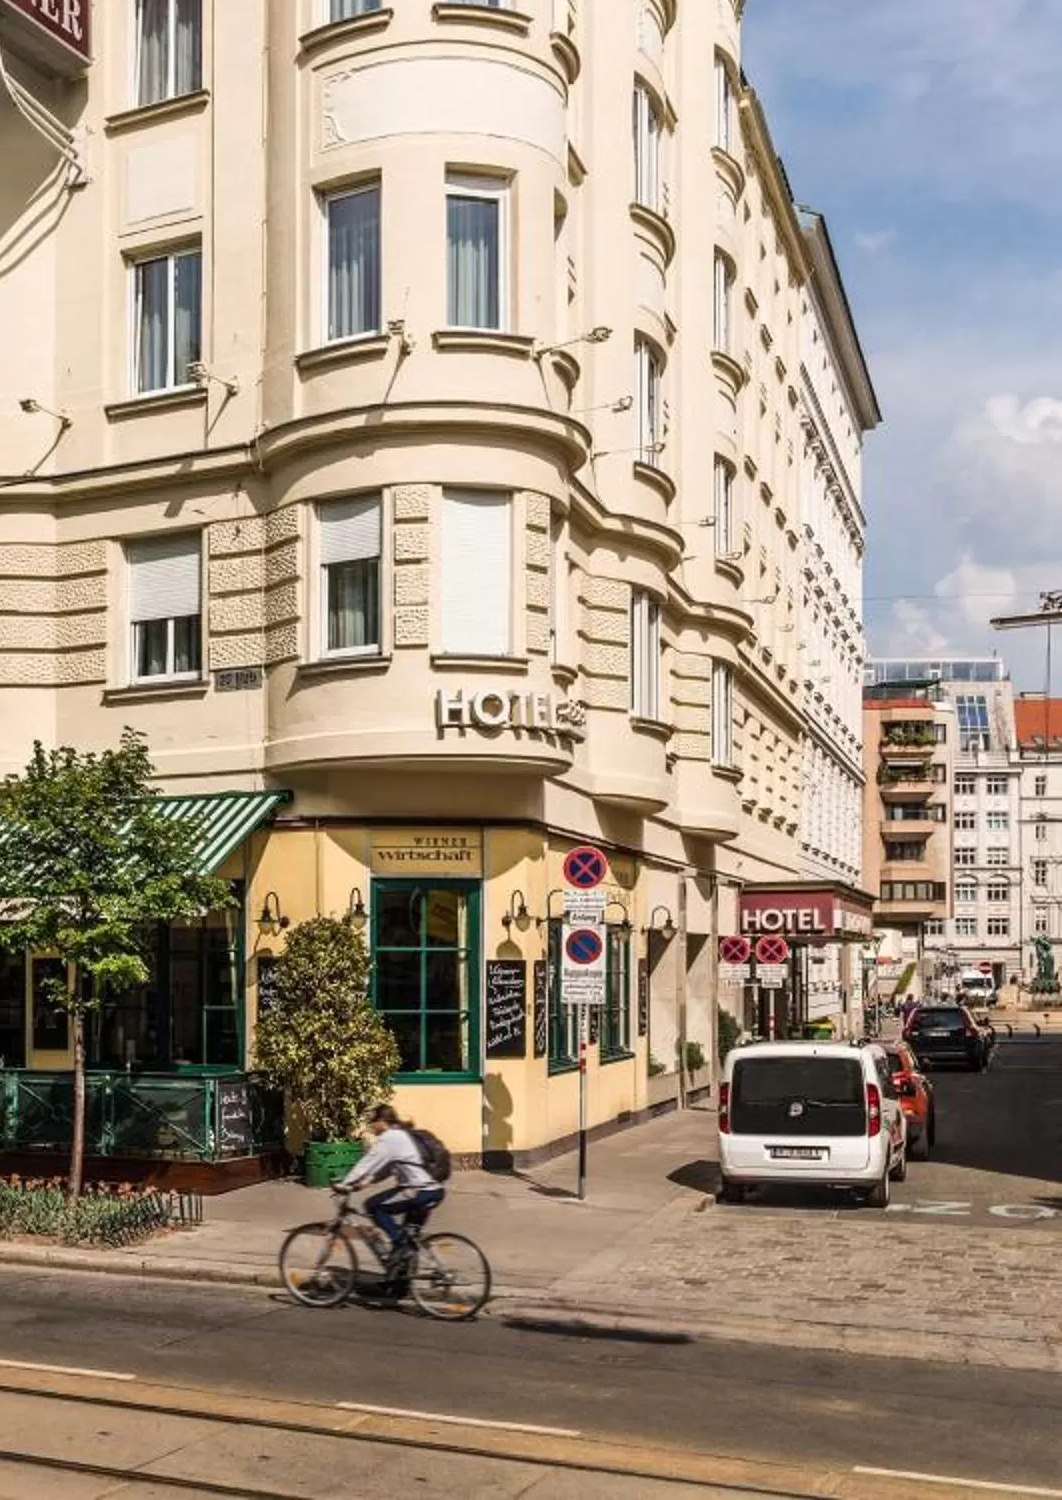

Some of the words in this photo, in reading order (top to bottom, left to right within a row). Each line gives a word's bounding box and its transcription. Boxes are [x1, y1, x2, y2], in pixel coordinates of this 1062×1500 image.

[435, 687, 568, 729] HOTEL
[414, 836, 467, 846] WIENER
[378, 849, 472, 861] wirtschaft
[742, 908, 827, 931] HOTEL
